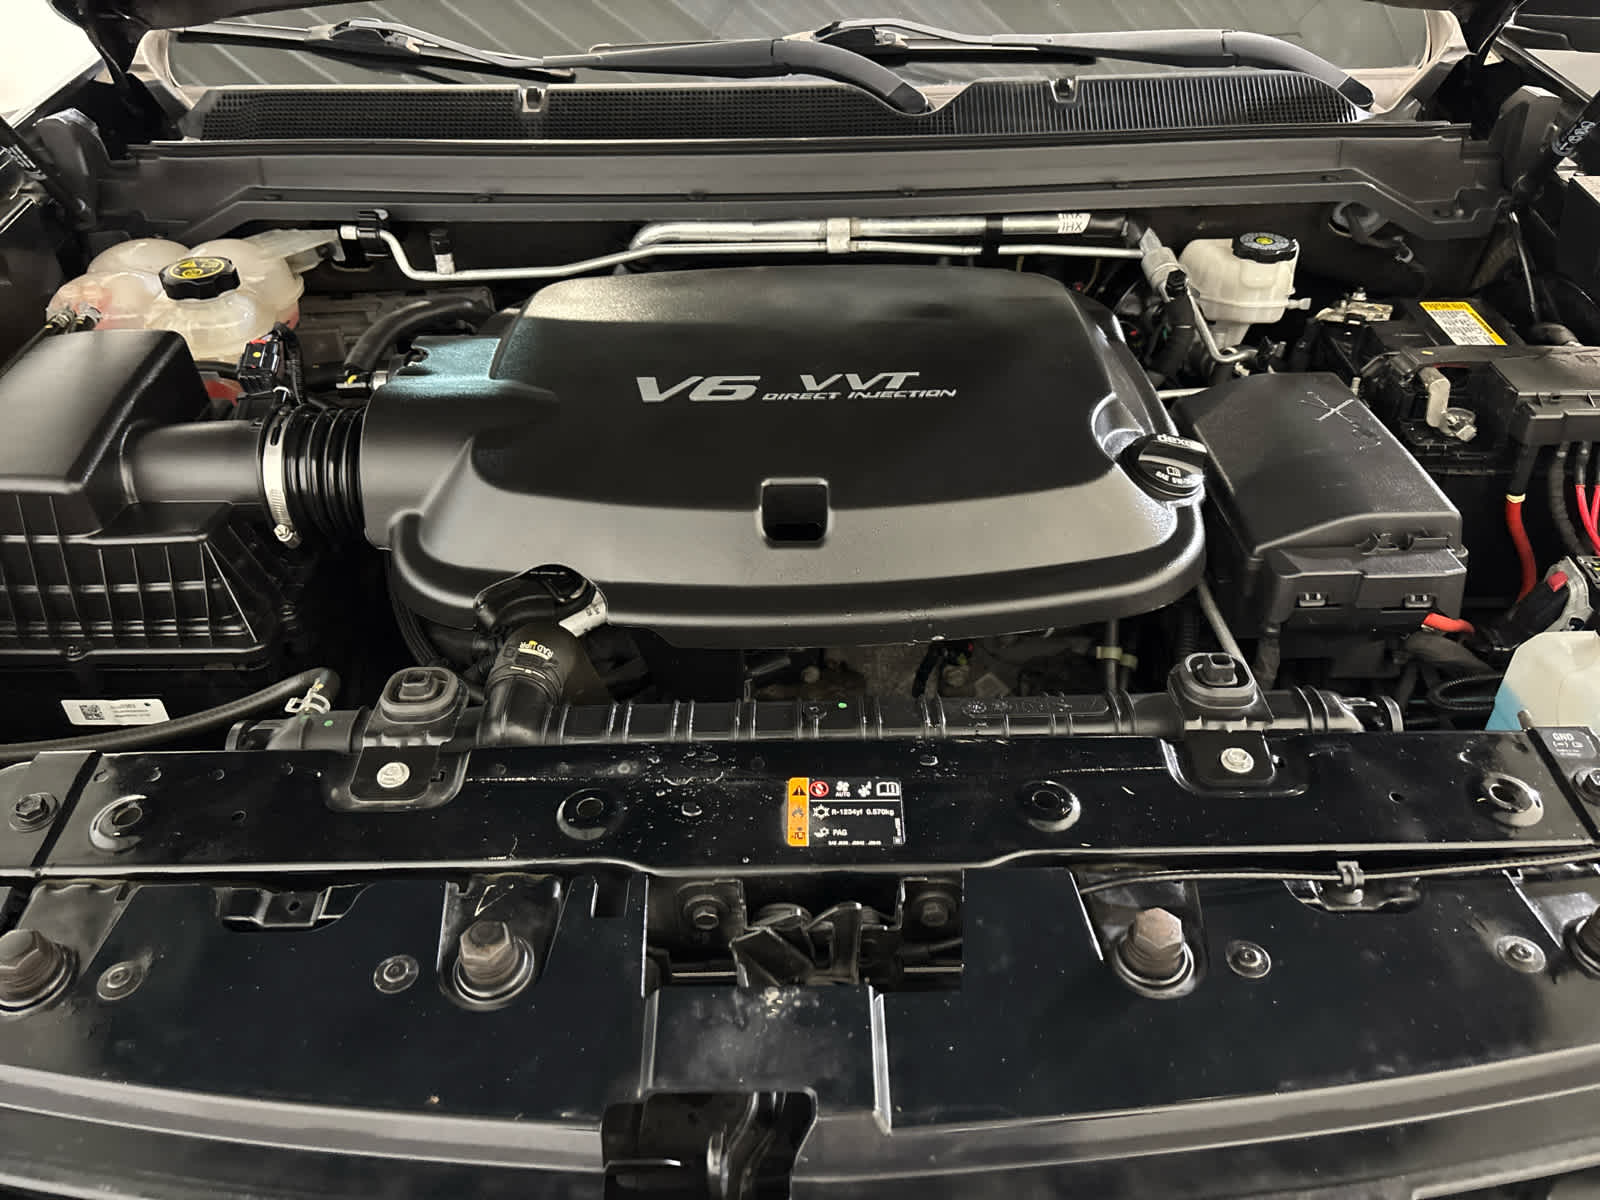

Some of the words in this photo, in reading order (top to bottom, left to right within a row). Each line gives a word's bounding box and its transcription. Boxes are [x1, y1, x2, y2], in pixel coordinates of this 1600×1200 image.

[636, 375, 760, 402] V6
[800, 371, 920, 391] VVT
[762, 392, 841, 400] DIRECT
[847, 389, 957, 400] INJECTION
[537, 644, 554, 658] RAD
[1552, 732, 1575, 741] GND
